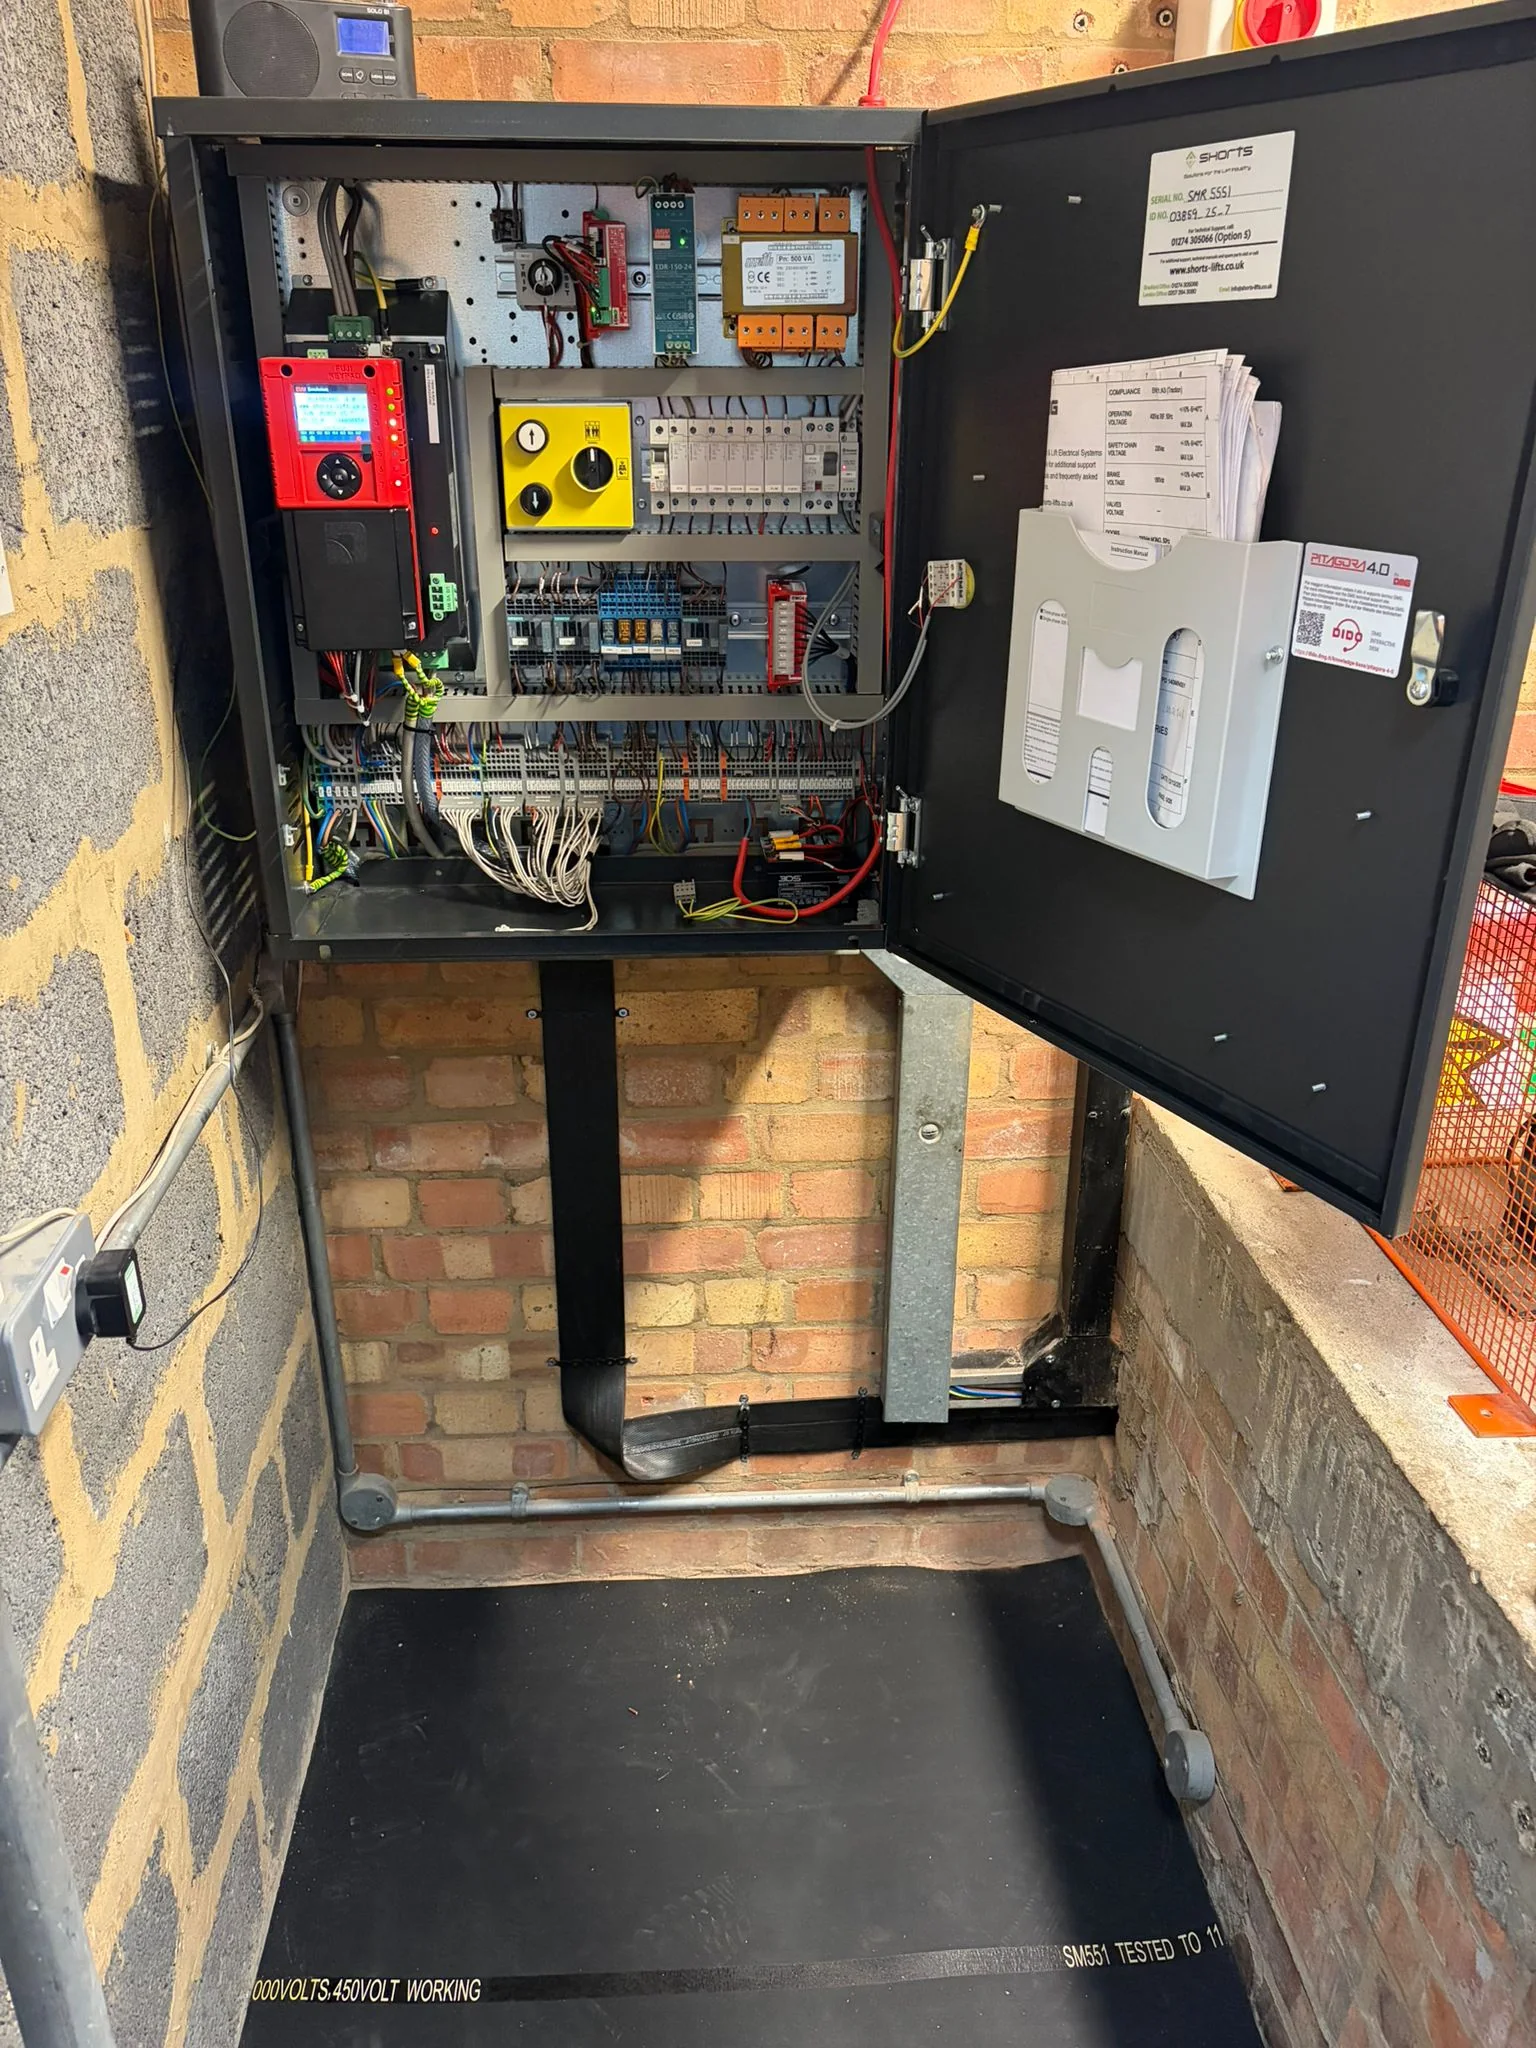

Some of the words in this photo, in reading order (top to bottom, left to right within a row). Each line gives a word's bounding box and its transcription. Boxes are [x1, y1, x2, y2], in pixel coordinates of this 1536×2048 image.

[367, 7, 383, 15] SOLO
[1151, 194, 1172, 205] SERIAL
[1171, 237, 1188, 246] 01274
[1190, 235, 1213, 245] 305066
[1214, 231, 1240, 243] (Option
[1170, 260, 1244, 276] www.shorts-lifts.co.uk
[1109, 388, 1141, 396] COMPLIANCE
[1081, 449, 1103, 458] Systems
[1077, 461, 1096, 469] support
[1059, 473, 1081, 481] frequently
[1111, 546, 1133, 554] Instruction
[1311, 552, 1367, 573] PITAGORA
[1367, 561, 1391, 577] 4.0
[1332, 627, 1363, 643] DIDO
[1063, 1943, 1111, 1968] SM551
[1114, 1938, 1175, 1965] TESTED
[1178, 1931, 1202, 1956] TO
[1206, 1923, 1224, 1949] 11
[406, 1978, 482, 2002] WORKING
